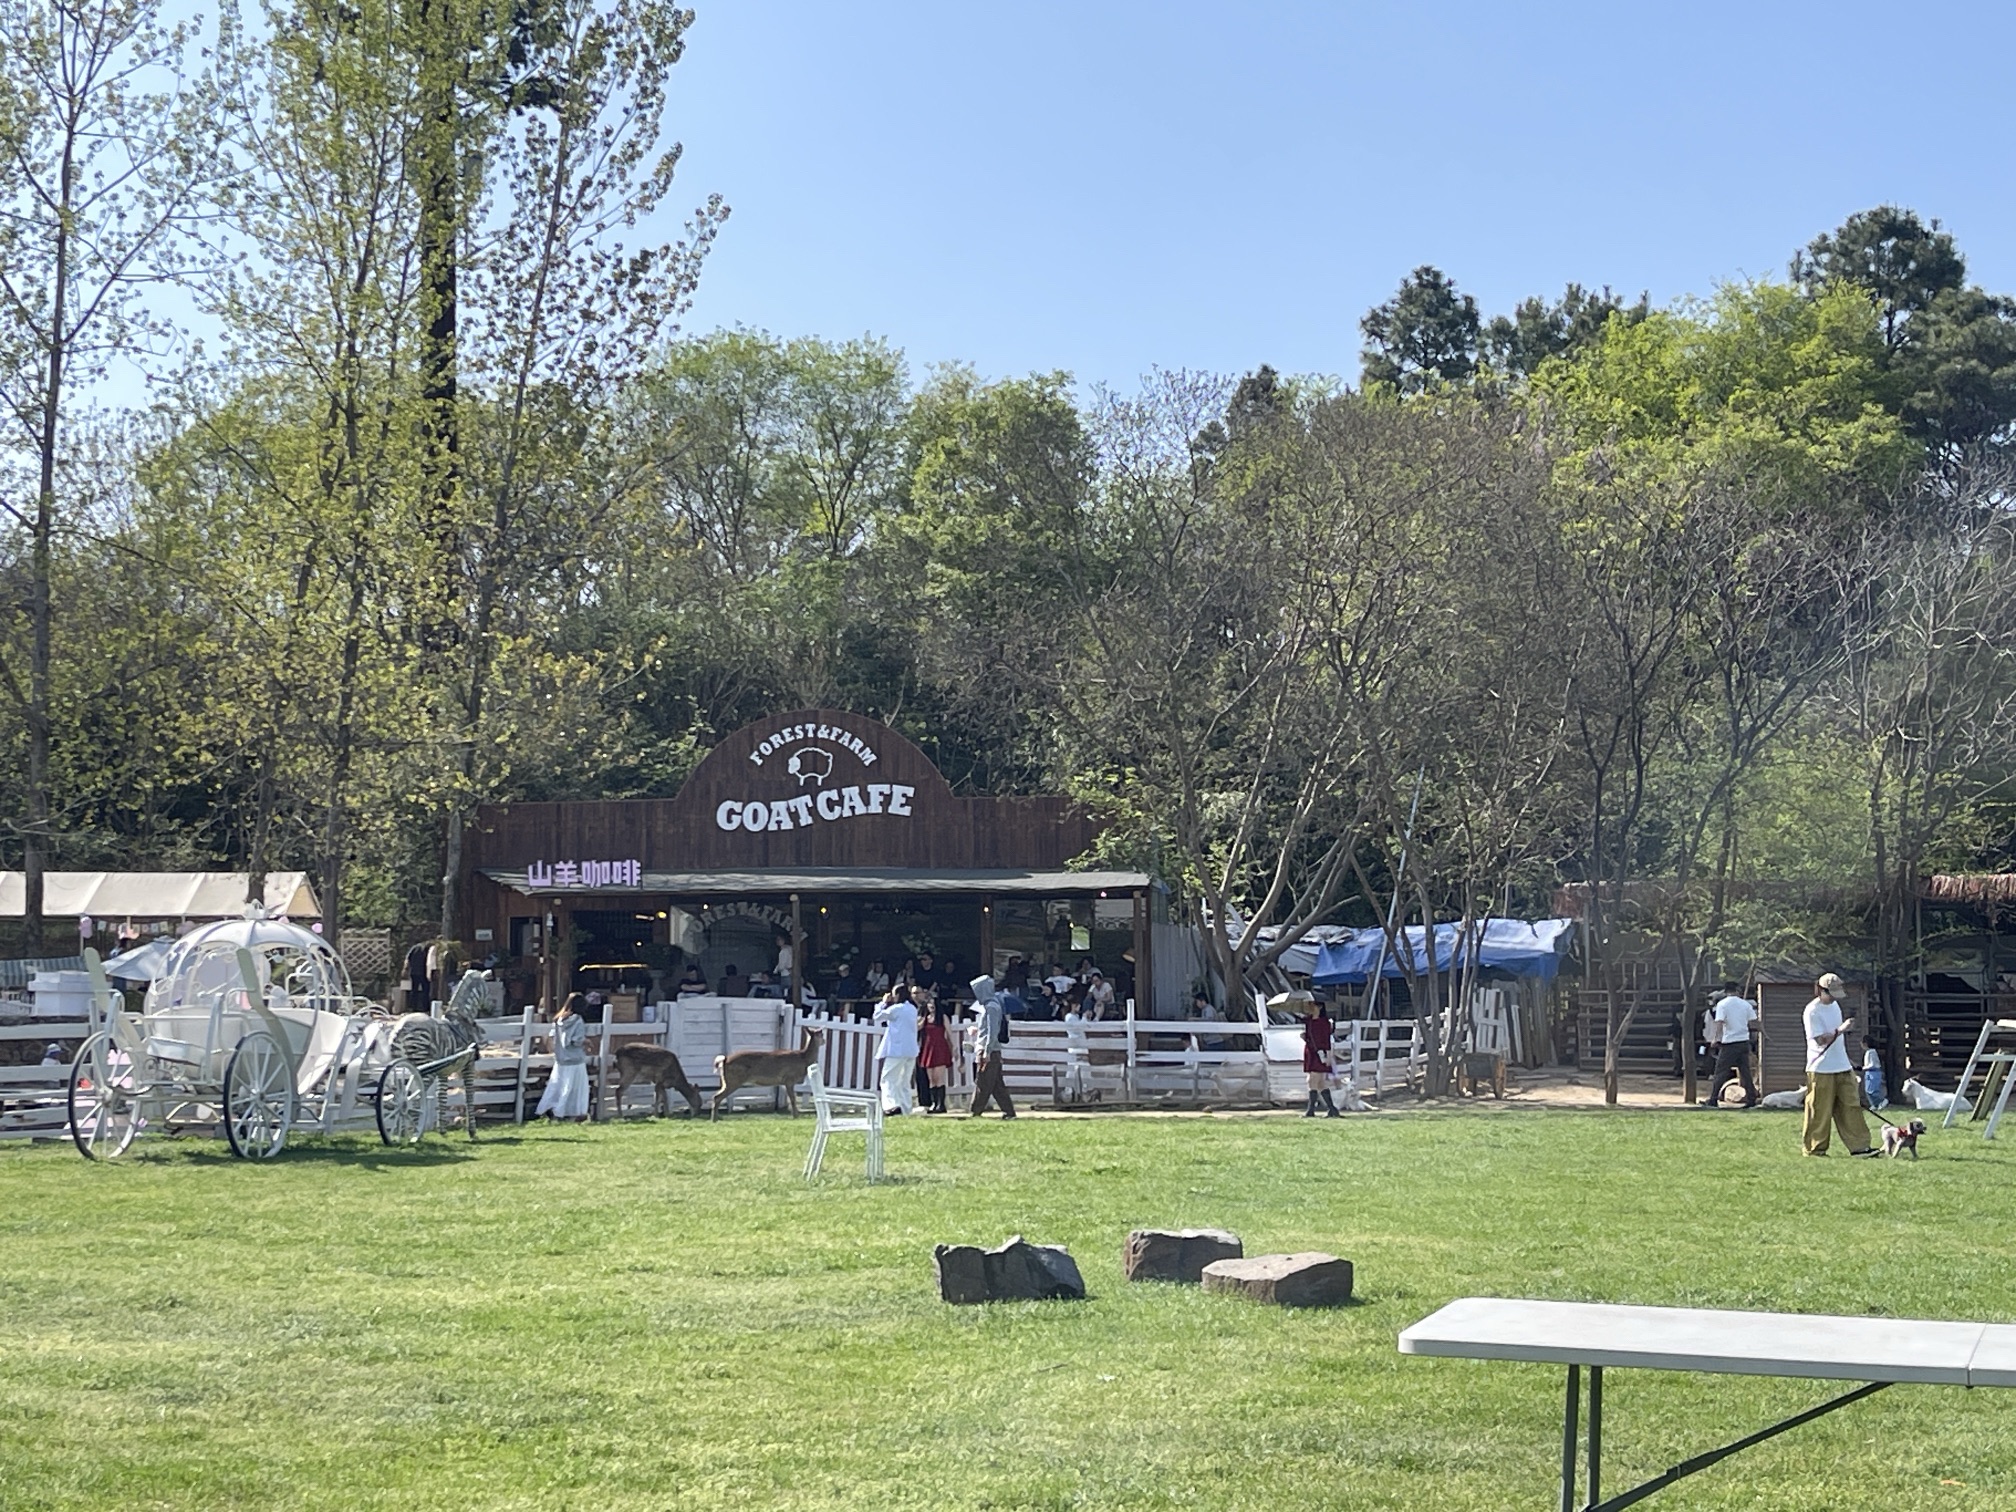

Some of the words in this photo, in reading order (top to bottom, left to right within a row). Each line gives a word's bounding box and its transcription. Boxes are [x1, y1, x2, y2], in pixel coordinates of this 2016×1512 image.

[749, 723, 878, 767] FOREST&FARM
[716, 794, 814, 832] GOAT
[816, 784, 915, 821] CAFE
[528, 859, 641, 888] 山羊咖啡
